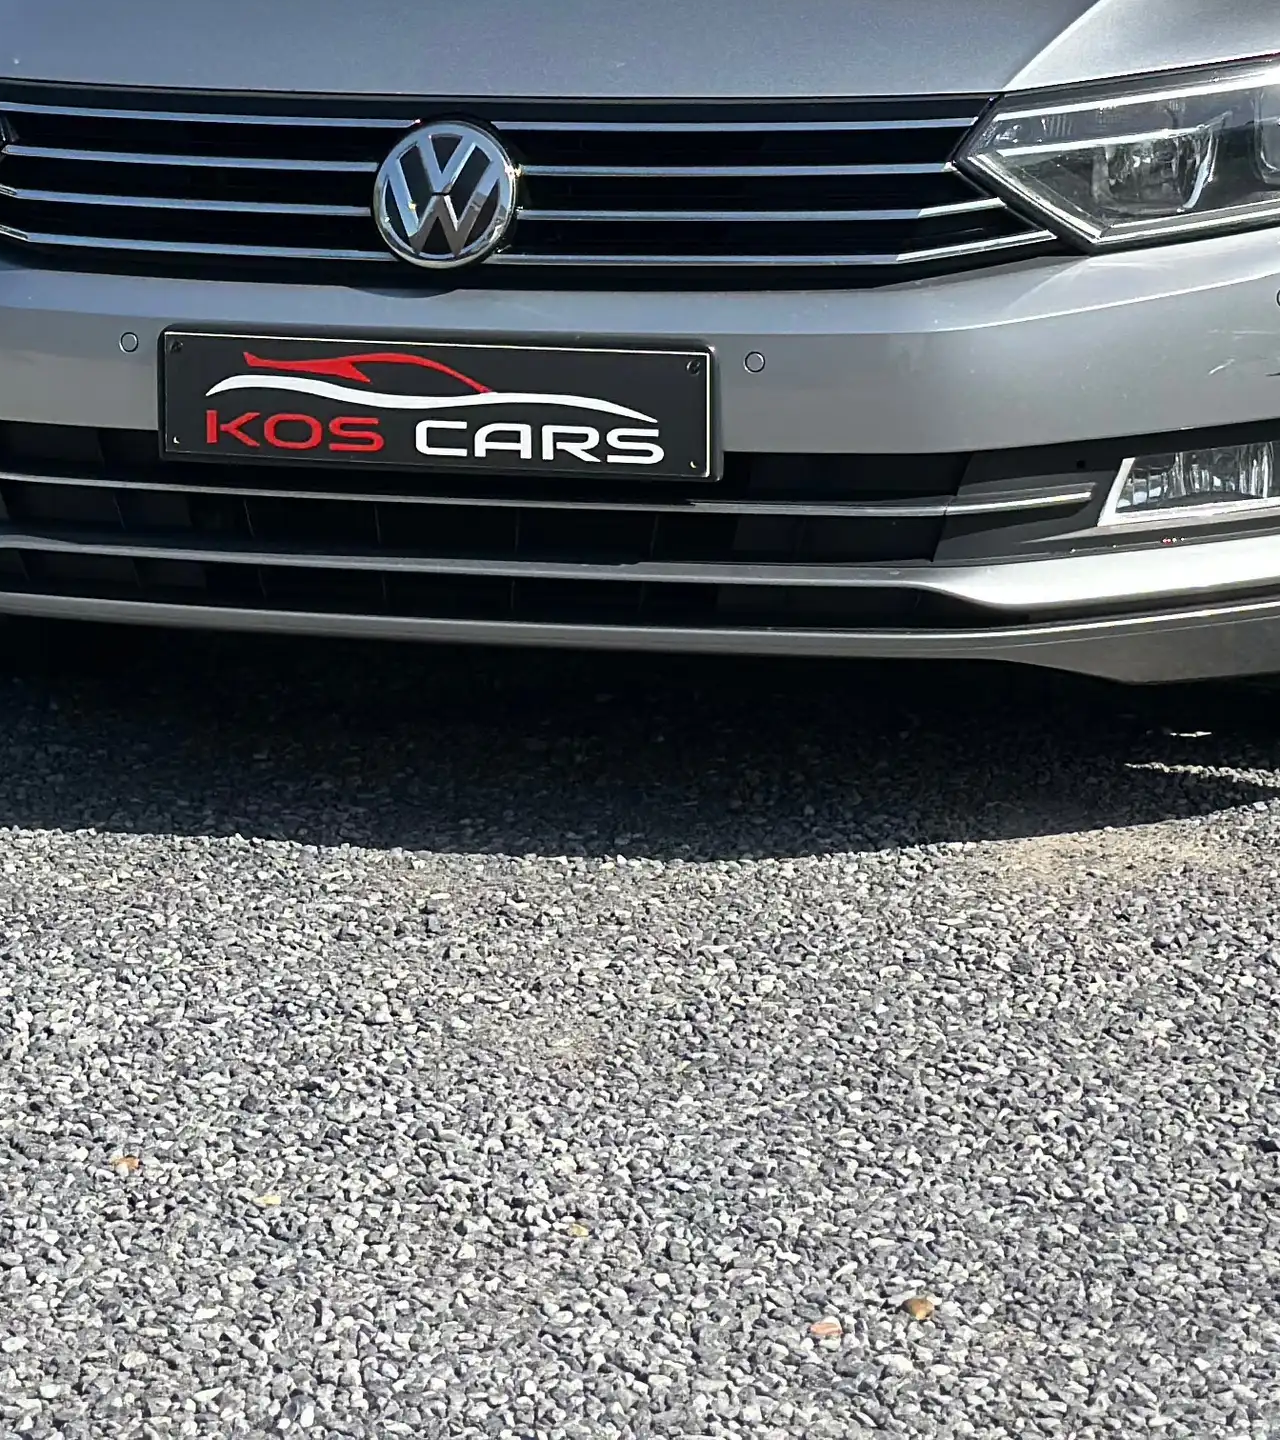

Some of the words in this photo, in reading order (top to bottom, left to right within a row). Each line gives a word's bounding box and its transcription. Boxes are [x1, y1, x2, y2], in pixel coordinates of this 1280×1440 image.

[383, 131, 503, 259] VW
[206, 409, 384, 452] KOS
[415, 419, 665, 465] CARS
